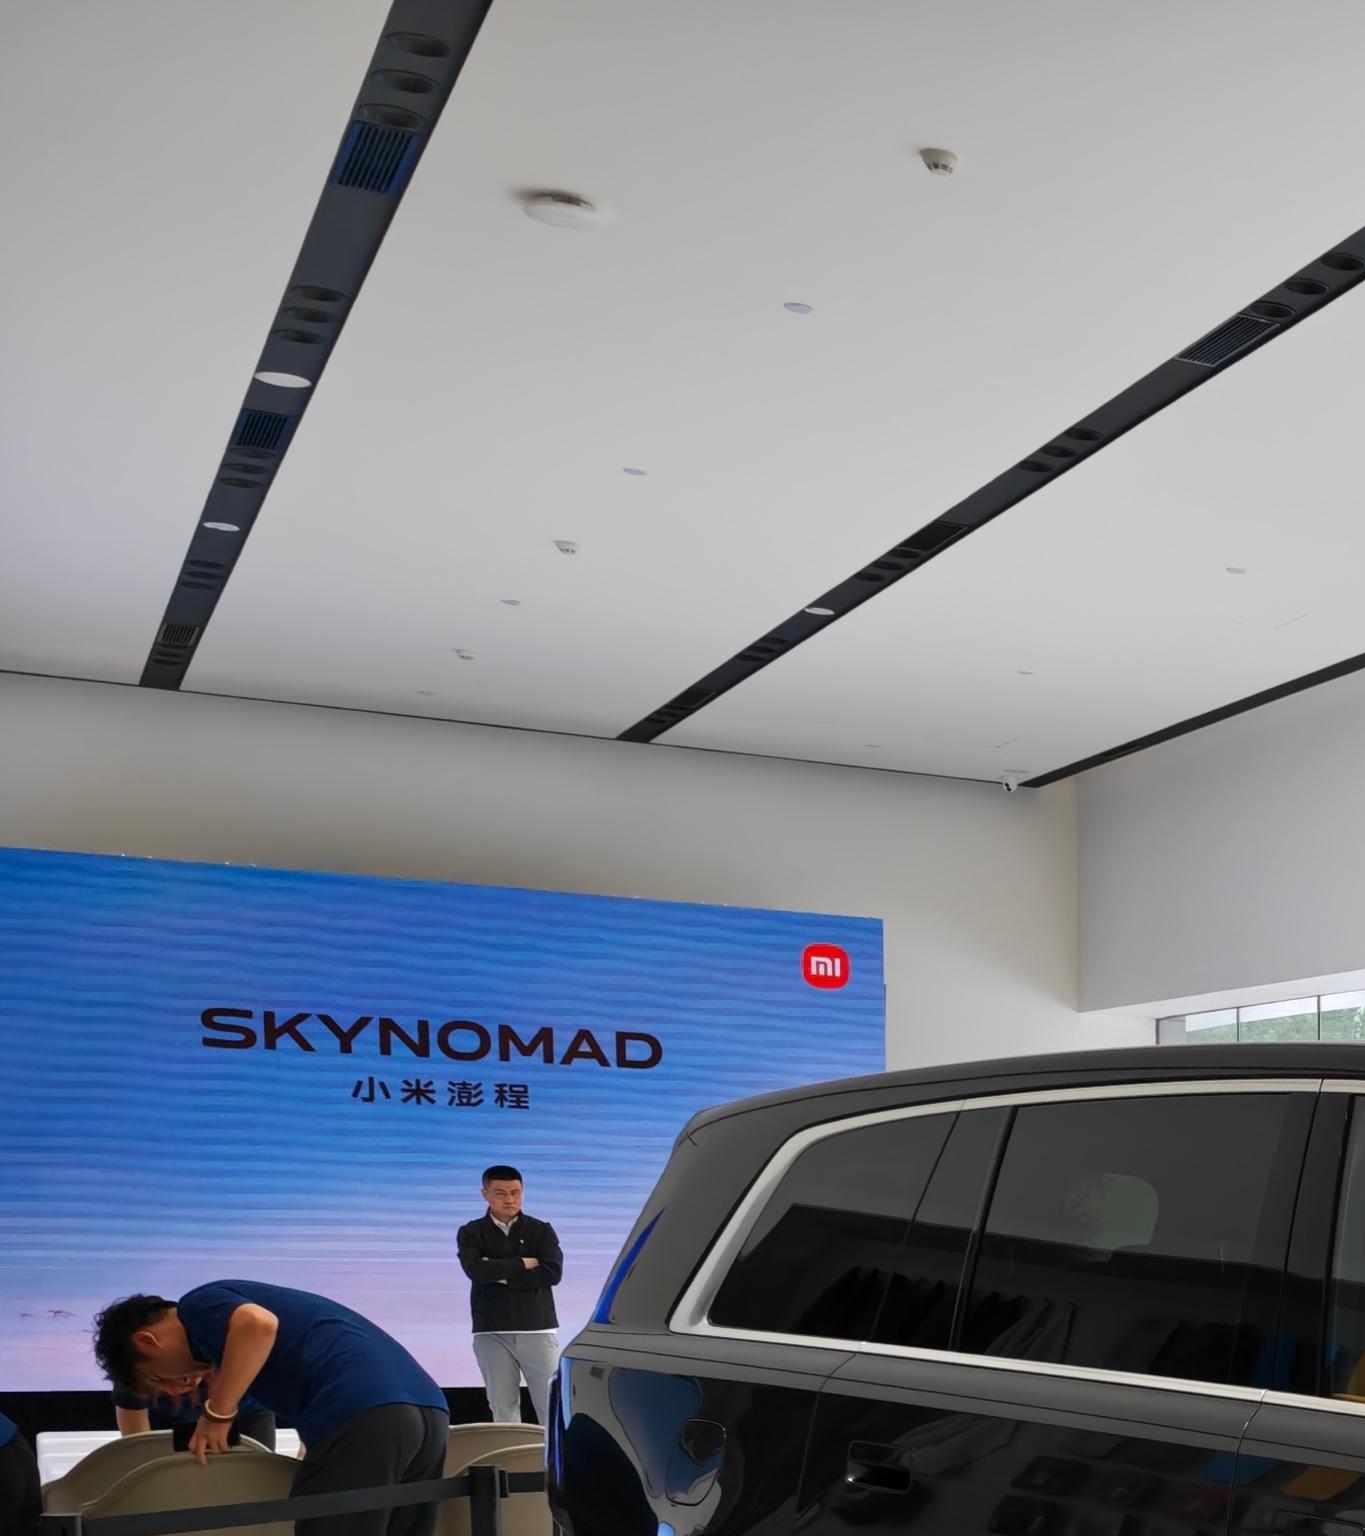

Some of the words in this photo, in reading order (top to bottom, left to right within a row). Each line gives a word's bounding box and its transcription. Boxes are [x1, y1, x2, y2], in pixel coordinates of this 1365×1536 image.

[201, 1007, 664, 1070] SKYNOMAD
[351, 1076, 531, 1110] 小米澎程
